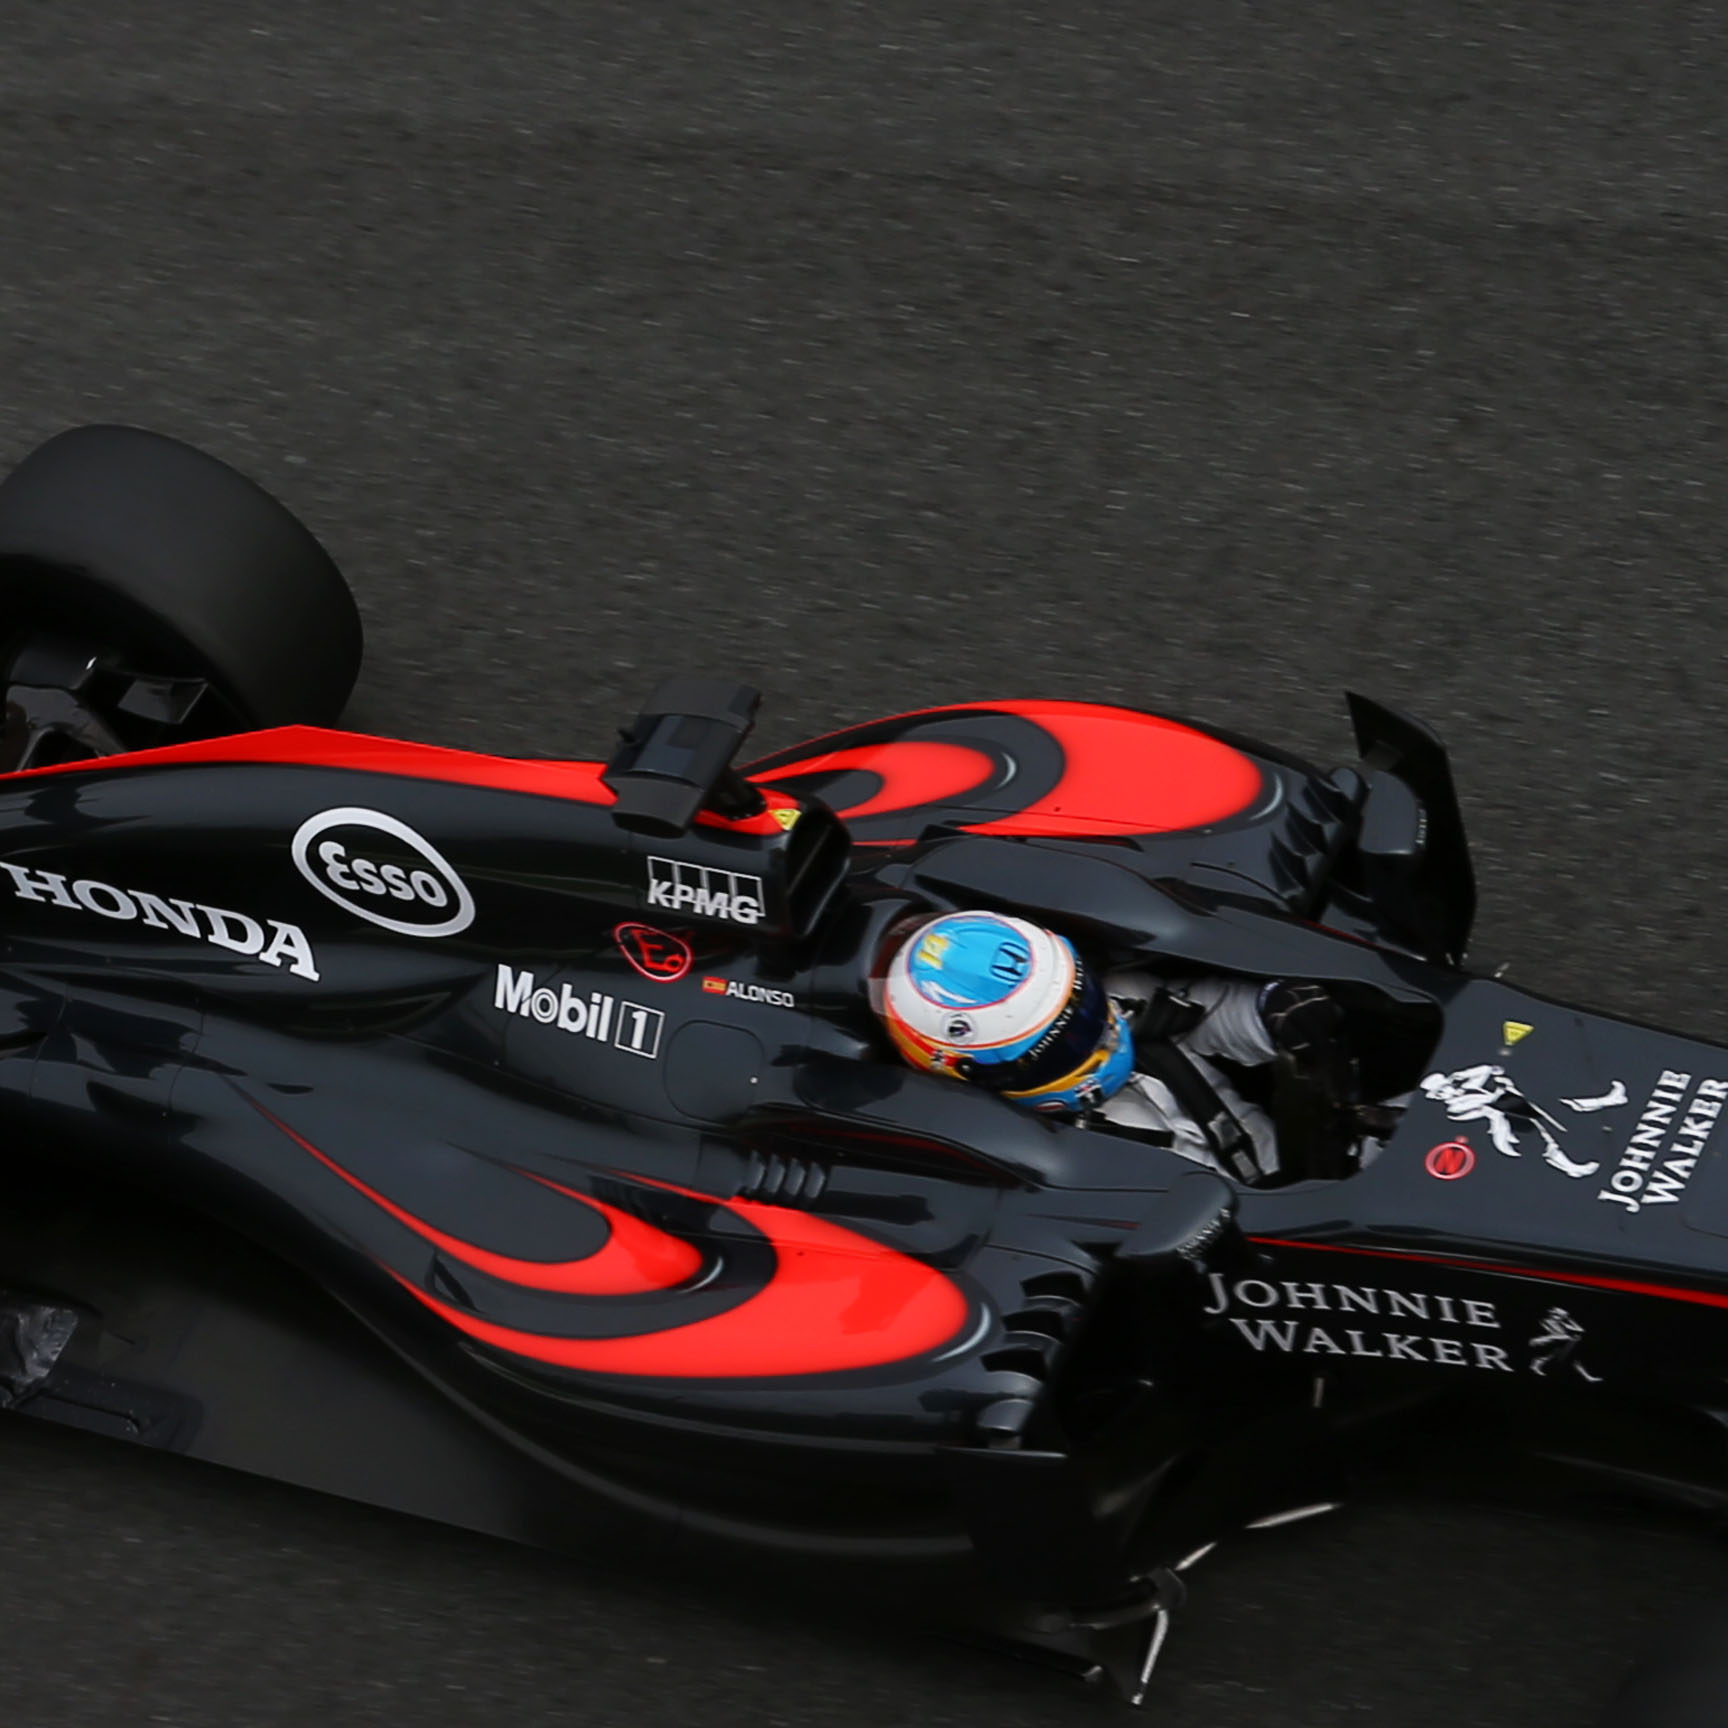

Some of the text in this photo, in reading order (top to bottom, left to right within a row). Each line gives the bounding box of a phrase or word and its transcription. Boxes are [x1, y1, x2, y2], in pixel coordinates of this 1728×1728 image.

[647, 877, 760, 925] KPMG
[494, 963, 615, 1043] Mobil
[725, 980, 796, 1008] ALONSO
[1597, 1068, 1693, 1213] JOHNNIE
[1203, 1272, 1502, 1329] JOHNNIE
[1228, 1317, 1515, 1372] WALKER
